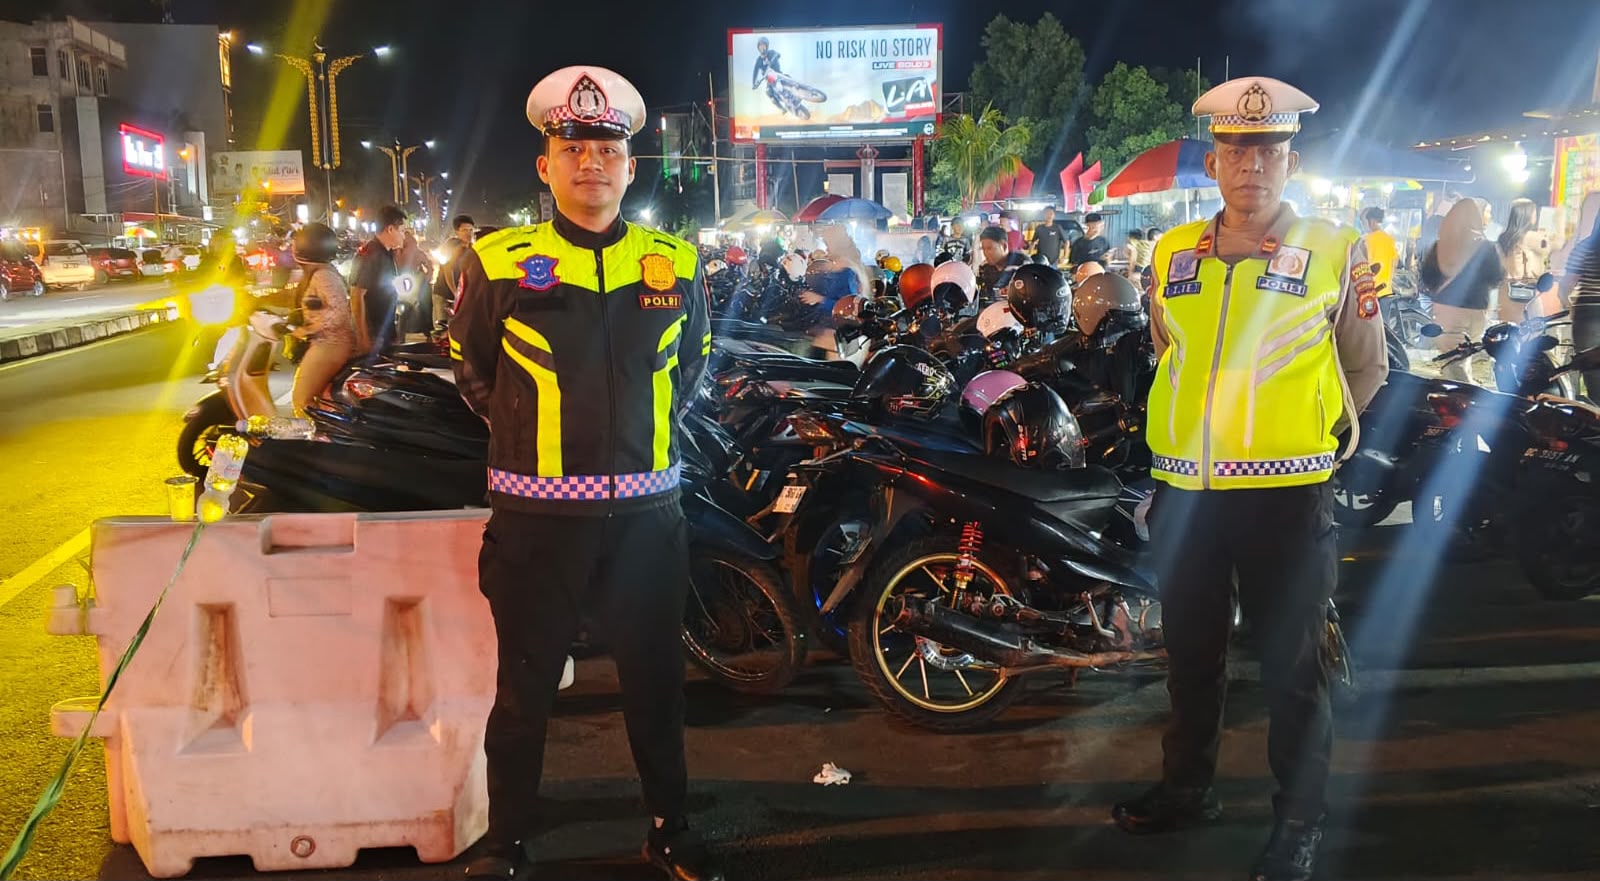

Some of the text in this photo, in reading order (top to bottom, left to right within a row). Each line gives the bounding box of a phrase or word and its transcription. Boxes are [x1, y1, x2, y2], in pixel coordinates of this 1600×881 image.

[816, 37, 931, 59] NO RISK NO STORY
[1258, 278, 1305, 295] POLISI
[643, 296, 678, 306] POLRI
